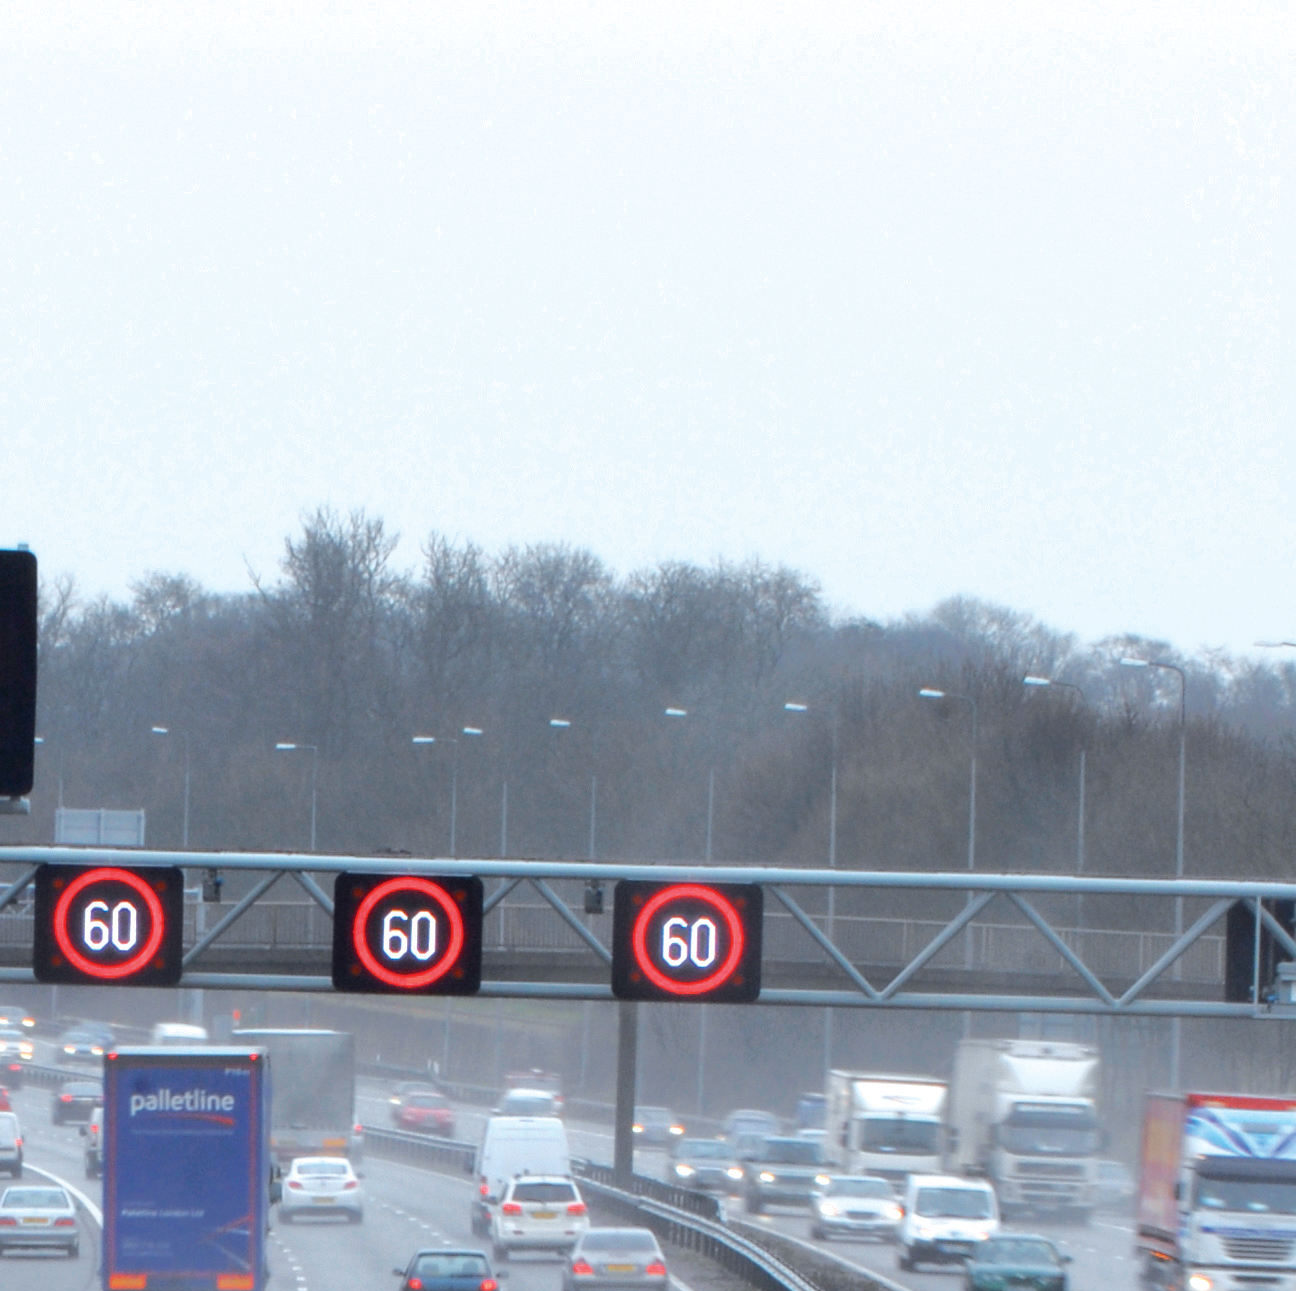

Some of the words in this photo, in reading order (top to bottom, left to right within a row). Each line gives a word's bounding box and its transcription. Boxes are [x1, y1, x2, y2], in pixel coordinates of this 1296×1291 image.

[82, 900, 139, 952] 60
[382, 910, 437, 961] 60
[661, 916, 717, 968] 60
[130, 1089, 235, 1117] palletline
